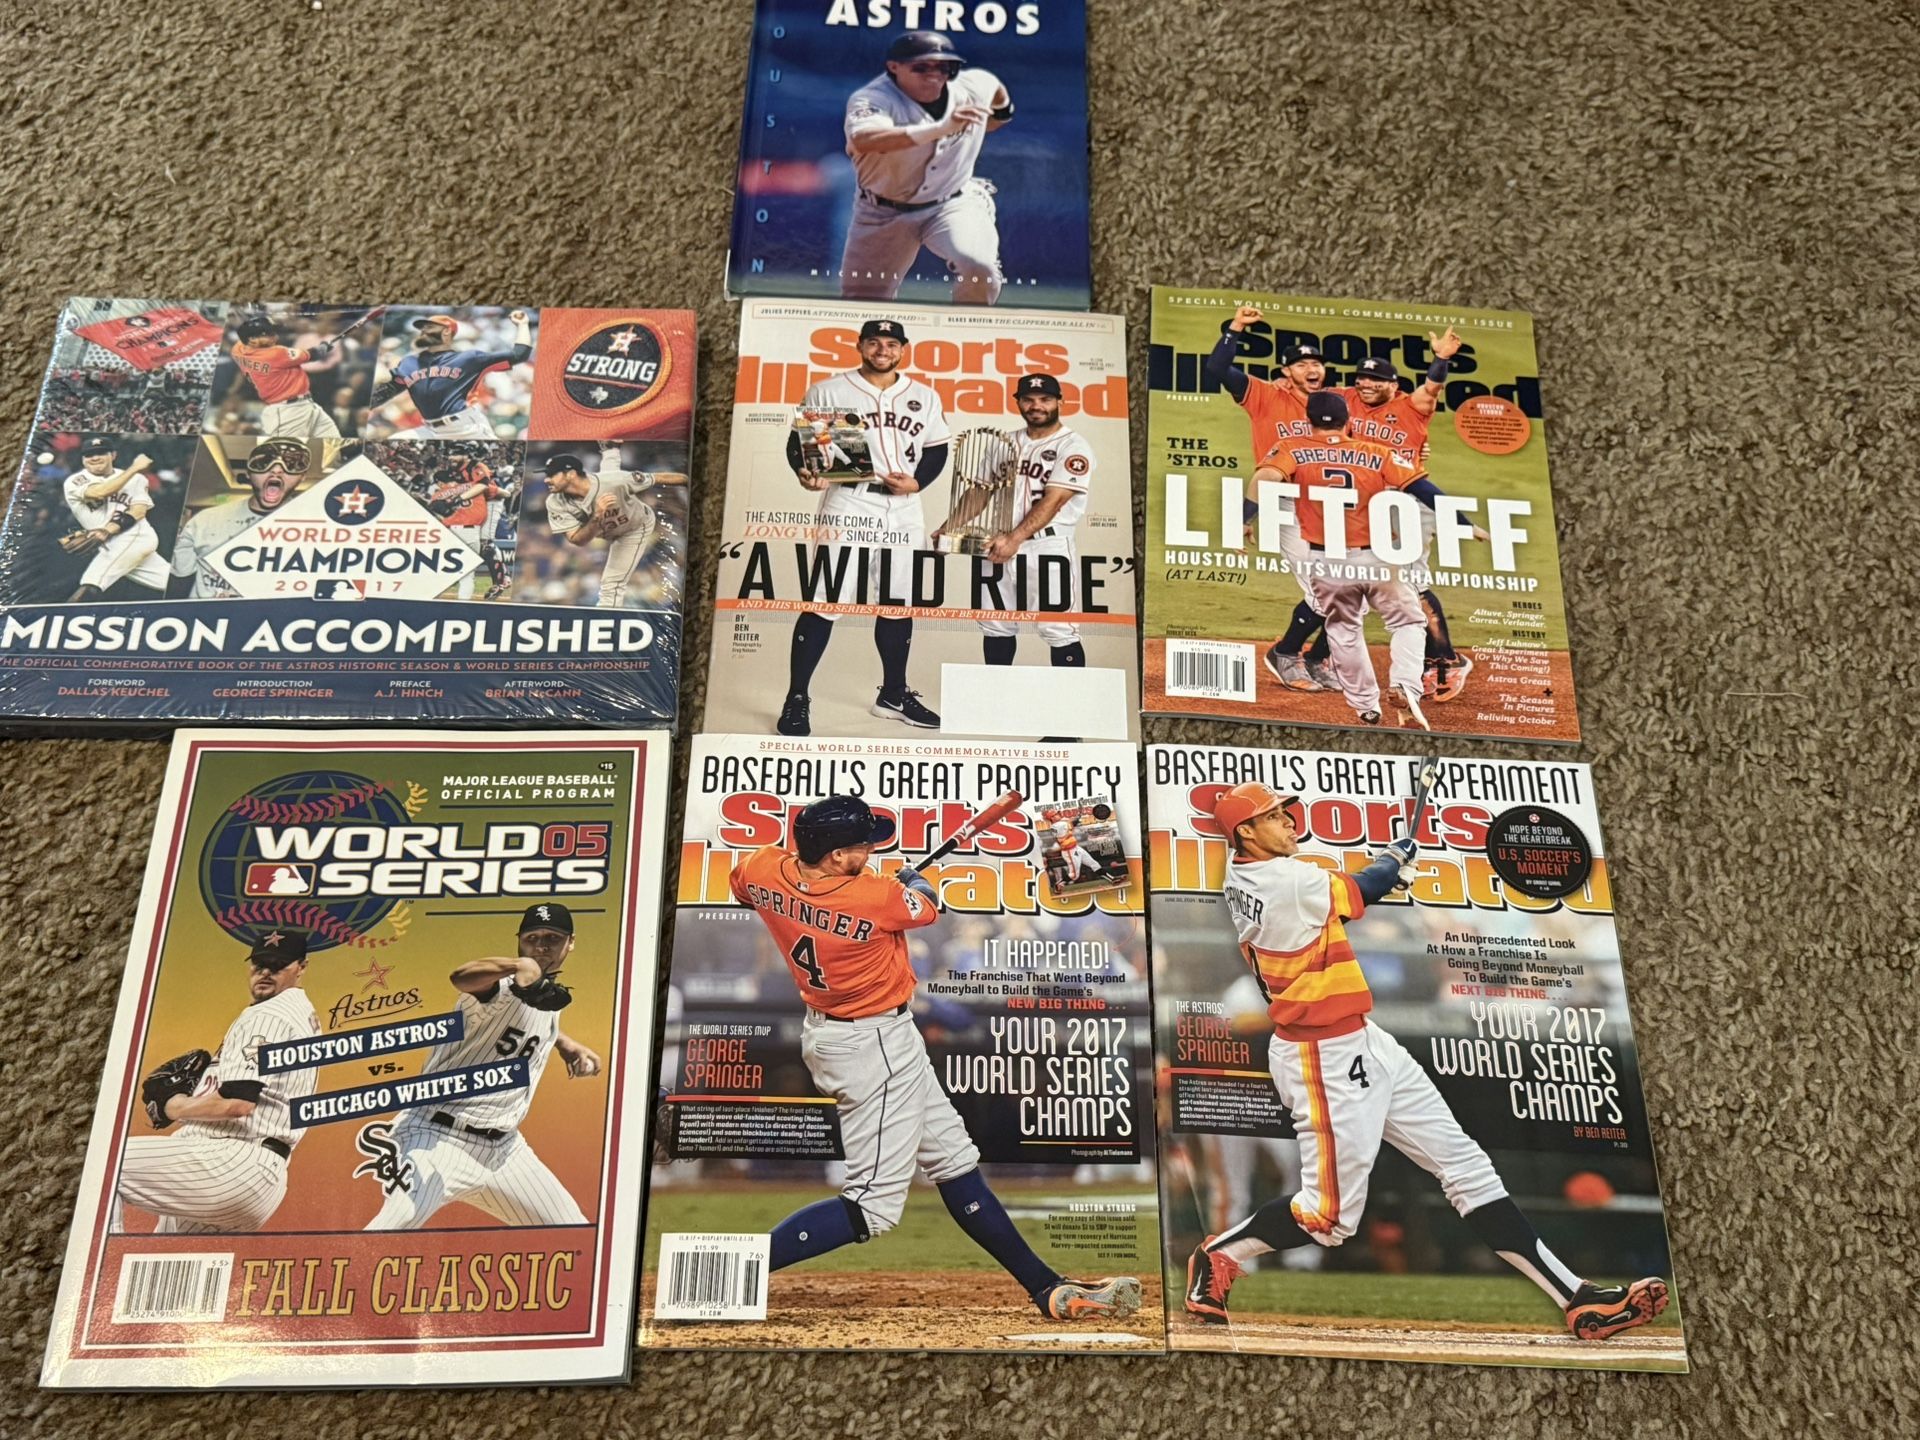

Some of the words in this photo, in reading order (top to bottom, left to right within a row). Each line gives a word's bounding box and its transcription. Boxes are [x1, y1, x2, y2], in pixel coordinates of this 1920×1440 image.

[826, 0, 1041, 34] ASTROS
[811, 269, 899, 280] MICHAEL
[1168, 296, 1226, 307] SPECIAL
[1233, 300, 1280, 311] WORLD
[1287, 305, 1335, 315] SERIES
[1343, 309, 1466, 325] COMMEMORATIVE
[1474, 318, 1513, 328] ISSUE
[566, 353, 657, 382] STRONG
[905, 442, 916, 463] 4
[1166, 436, 1209, 450] THE
[1292, 447, 1384, 470] BREGMAN
[745, 511, 766, 524] THE
[767, 512, 811, 525] ASTROS
[813, 513, 842, 526] HAVE
[843, 514, 874, 527] COME
[1164, 473, 1531, 572] LIFTOFF
[258, 527, 353, 543] WORLD
[358, 528, 441, 544] SERIES
[743, 525, 800, 538] LONG
[802, 528, 844, 540] WAY
[846, 529, 879, 542] SINCE
[882, 531, 909, 544] 2014
[224, 546, 463, 574] CHAMPIONS
[796, 544, 945, 608] WILD
[1164, 550, 1248, 569] HOUSTON
[1255, 556, 1290, 573] HAS
[1297, 561, 1324, 575] ITS
[1330, 563, 1391, 581] WORLD
[1399, 569, 1538, 592] CHAMPIONSHIP
[737, 600, 760, 609] AND
[762, 600, 791, 609] THIS
[792, 602, 834, 612] WORLD
[834, 604, 874, 614] SERIES
[877, 607, 920, 616] TROPHY
[975, 609, 1010, 620] THEIR
[1011, 611, 1039, 621] LAST
[1, 615, 229, 652] MISSION
[241, 619, 654, 653] ACCOMPLISHED
[24, 658, 79, 668] OFFICIAL
[83, 659, 194, 670] COMMEMORATIVE
[199, 660, 234, 670] BOOK
[239, 661, 256, 670] OF
[260, 661, 283, 670] THE
[287, 662, 335, 671] ASTROS
[339, 662, 397, 671] HISTORIC
[401, 662, 449, 671] SEASON
[467, 662, 509, 670] WORLD
[513, 662, 554, 671] SERIES
[558, 661, 651, 671] CHAMPIONSHIP
[88, 678, 145, 687] FOREWORD
[237, 679, 313, 688] INTRODUCTION
[390, 680, 431, 688] PREFACE
[1487, 675, 1517, 684] Astros
[1520, 677, 1551, 686] Greats
[57, 686, 110, 696] DALLAS
[110, 687, 170, 697] KEUCHEL
[212, 688, 266, 697] GEORGE
[269, 689, 334, 698] SPRINGER
[402, 689, 444, 698] HINCH
[1477, 713, 1515, 724] Reliving
[1519, 715, 1557, 725] October
[759, 741, 814, 751] SPECIAL
[817, 744, 862, 754] WORLD
[866, 745, 911, 755] SERIES
[914, 746, 1030, 758] COMMEMORATIVE
[1033, 749, 1070, 759] ISSUE
[442, 775, 488, 787] MAJOR
[492, 775, 543, 787] LEAGUE
[701, 756, 866, 799] BASEBALL'S
[878, 760, 964, 801] GREAT
[1154, 748, 1306, 791] BASEBALL'S
[1317, 756, 1396, 797] GREAT
[441, 788, 523, 800] OFFICIAL
[532, 787, 616, 799] PROGRAM
[1504, 834, 1518, 843] THE
[1520, 834, 1572, 845] HEARTBREAK
[1509, 824, 1530, 834] HOPE
[1532, 826, 1563, 835] BEYOND
[254, 825, 542, 860] WORLD
[542, 824, 608, 857] 05
[1524, 849, 1581, 864] SOCCER'S
[317, 859, 606, 896] SERIES
[1517, 861, 1569, 876] MOMENT
[699, 913, 750, 921] PRESENTS
[746, 884, 875, 941] SPRINGER
[1461, 933, 1546, 948] Unprecedented
[1549, 939, 1576, 950] Look
[791, 933, 830, 991] 4
[984, 939, 999, 967] IT
[1007, 940, 1110, 969] HAPPENED!
[1441, 946, 1465, 956] How
[1478, 946, 1532, 960] Franchise
[1447, 958, 1480, 972] Going
[1482, 960, 1523, 973] Beyond
[1526, 963, 1584, 977] Moneyball
[947, 970, 967, 981] The
[970, 971, 1023, 982] Franchise
[1025, 972, 1052, 983] That
[1053, 972, 1082, 983] Went
[1085, 973, 1126, 986] Beyond
[1479, 973, 1507, 985] Build
[1509, 975, 1528, 986] the
[1531, 976, 1573, 988] Game's
[927, 983, 985, 996] Moneyball
[1002, 985, 1030, 995] Build
[1032, 986, 1050, 996] the
[1053, 987, 1093, 997] Game's
[1451, 984, 1481, 996] NEXT
[328, 986, 422, 1029] Astros
[1007, 998, 1035, 1009] NEW
[1039, 999, 1062, 1009] BIG
[1175, 1000, 1190, 1013] THE
[703, 1025, 727, 1035] WORLD
[730, 1025, 753, 1036] SERIES
[1176, 1016, 1232, 1041] GEORGE
[1470, 1000, 1539, 1042] YOUR
[1546, 1006, 1607, 1045] 2017
[495, 1025, 541, 1061] 56
[990, 1016, 1057, 1055] YOUR
[1066, 1018, 1127, 1056] 2017
[266, 1033, 365, 1069] HOUSTON
[686, 1039, 747, 1062] GEORGE
[1177, 1039, 1250, 1065] SPRINGER
[1431, 1036, 1523, 1079] WORLD
[1530, 1042, 1617, 1084] SERIES
[367, 1063, 405, 1077] vs.
[684, 1064, 763, 1089] SPRINGER
[946, 1055, 1036, 1095] WORLD
[1046, 1057, 1130, 1096] SERIES
[1348, 1053, 1370, 1089] 4
[298, 1088, 392, 1123] CHICAGO
[398, 1074, 468, 1104] WHITE
[1509, 1080, 1623, 1125] CHAMPS
[1020, 1096, 1132, 1137] CHAMPS
[1601, 1127, 1626, 1140] REITER
[236, 1257, 355, 1318] FALL
